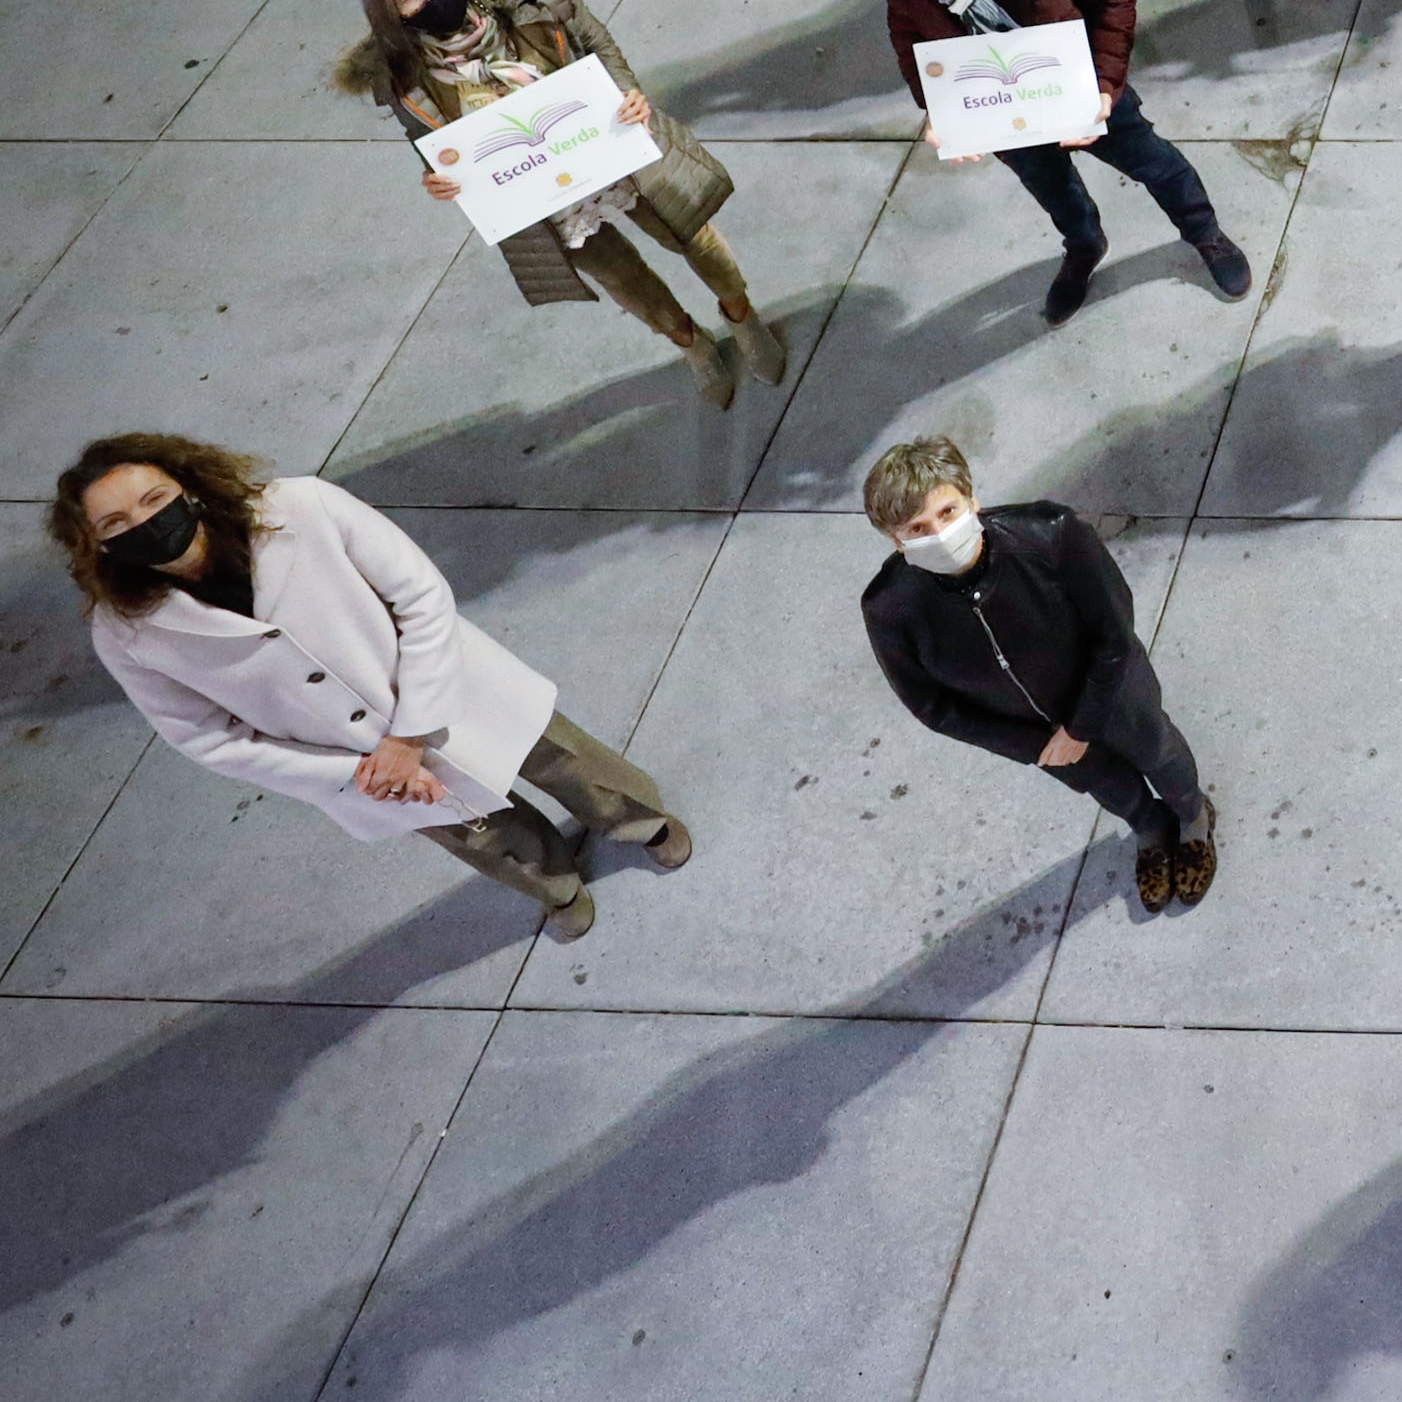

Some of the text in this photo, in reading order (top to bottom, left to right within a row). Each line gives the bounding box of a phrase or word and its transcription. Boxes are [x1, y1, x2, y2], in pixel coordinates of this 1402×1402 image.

[963, 83, 1063, 109] Escola Verda
[492, 124, 600, 186] Escola Verda
